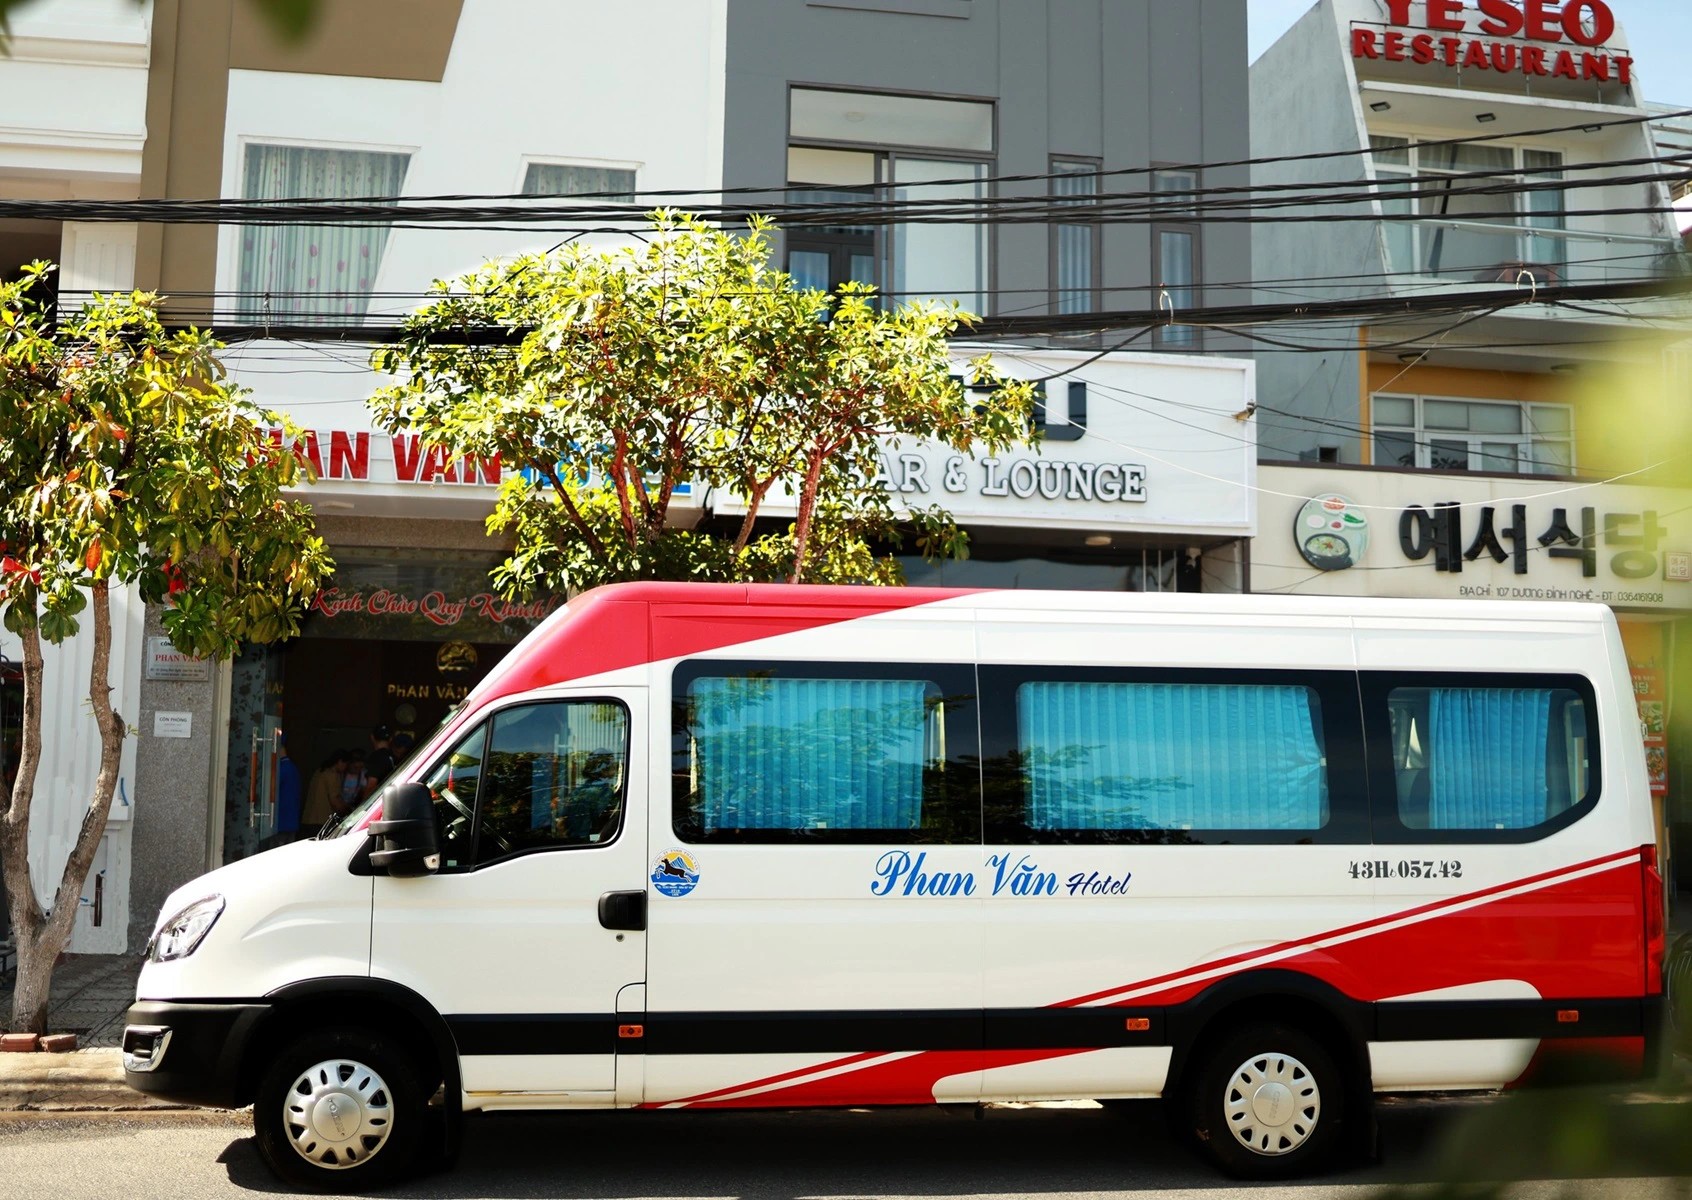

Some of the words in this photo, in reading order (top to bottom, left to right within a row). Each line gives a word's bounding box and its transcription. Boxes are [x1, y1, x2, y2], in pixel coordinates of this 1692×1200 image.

[1351, 28, 1634, 85] RESTAURANT
[943, 455, 967, 493] &
[981, 458, 1148, 502] LOUNGE
[1399, 501, 1667, 579] 예서식당
[367, 589, 417, 615] Chào
[1496, 587, 1509, 597] 107
[870, 850, 977, 897] Phan
[985, 852, 1059, 897] Văn
[1065, 871, 1132, 896] Hotel
